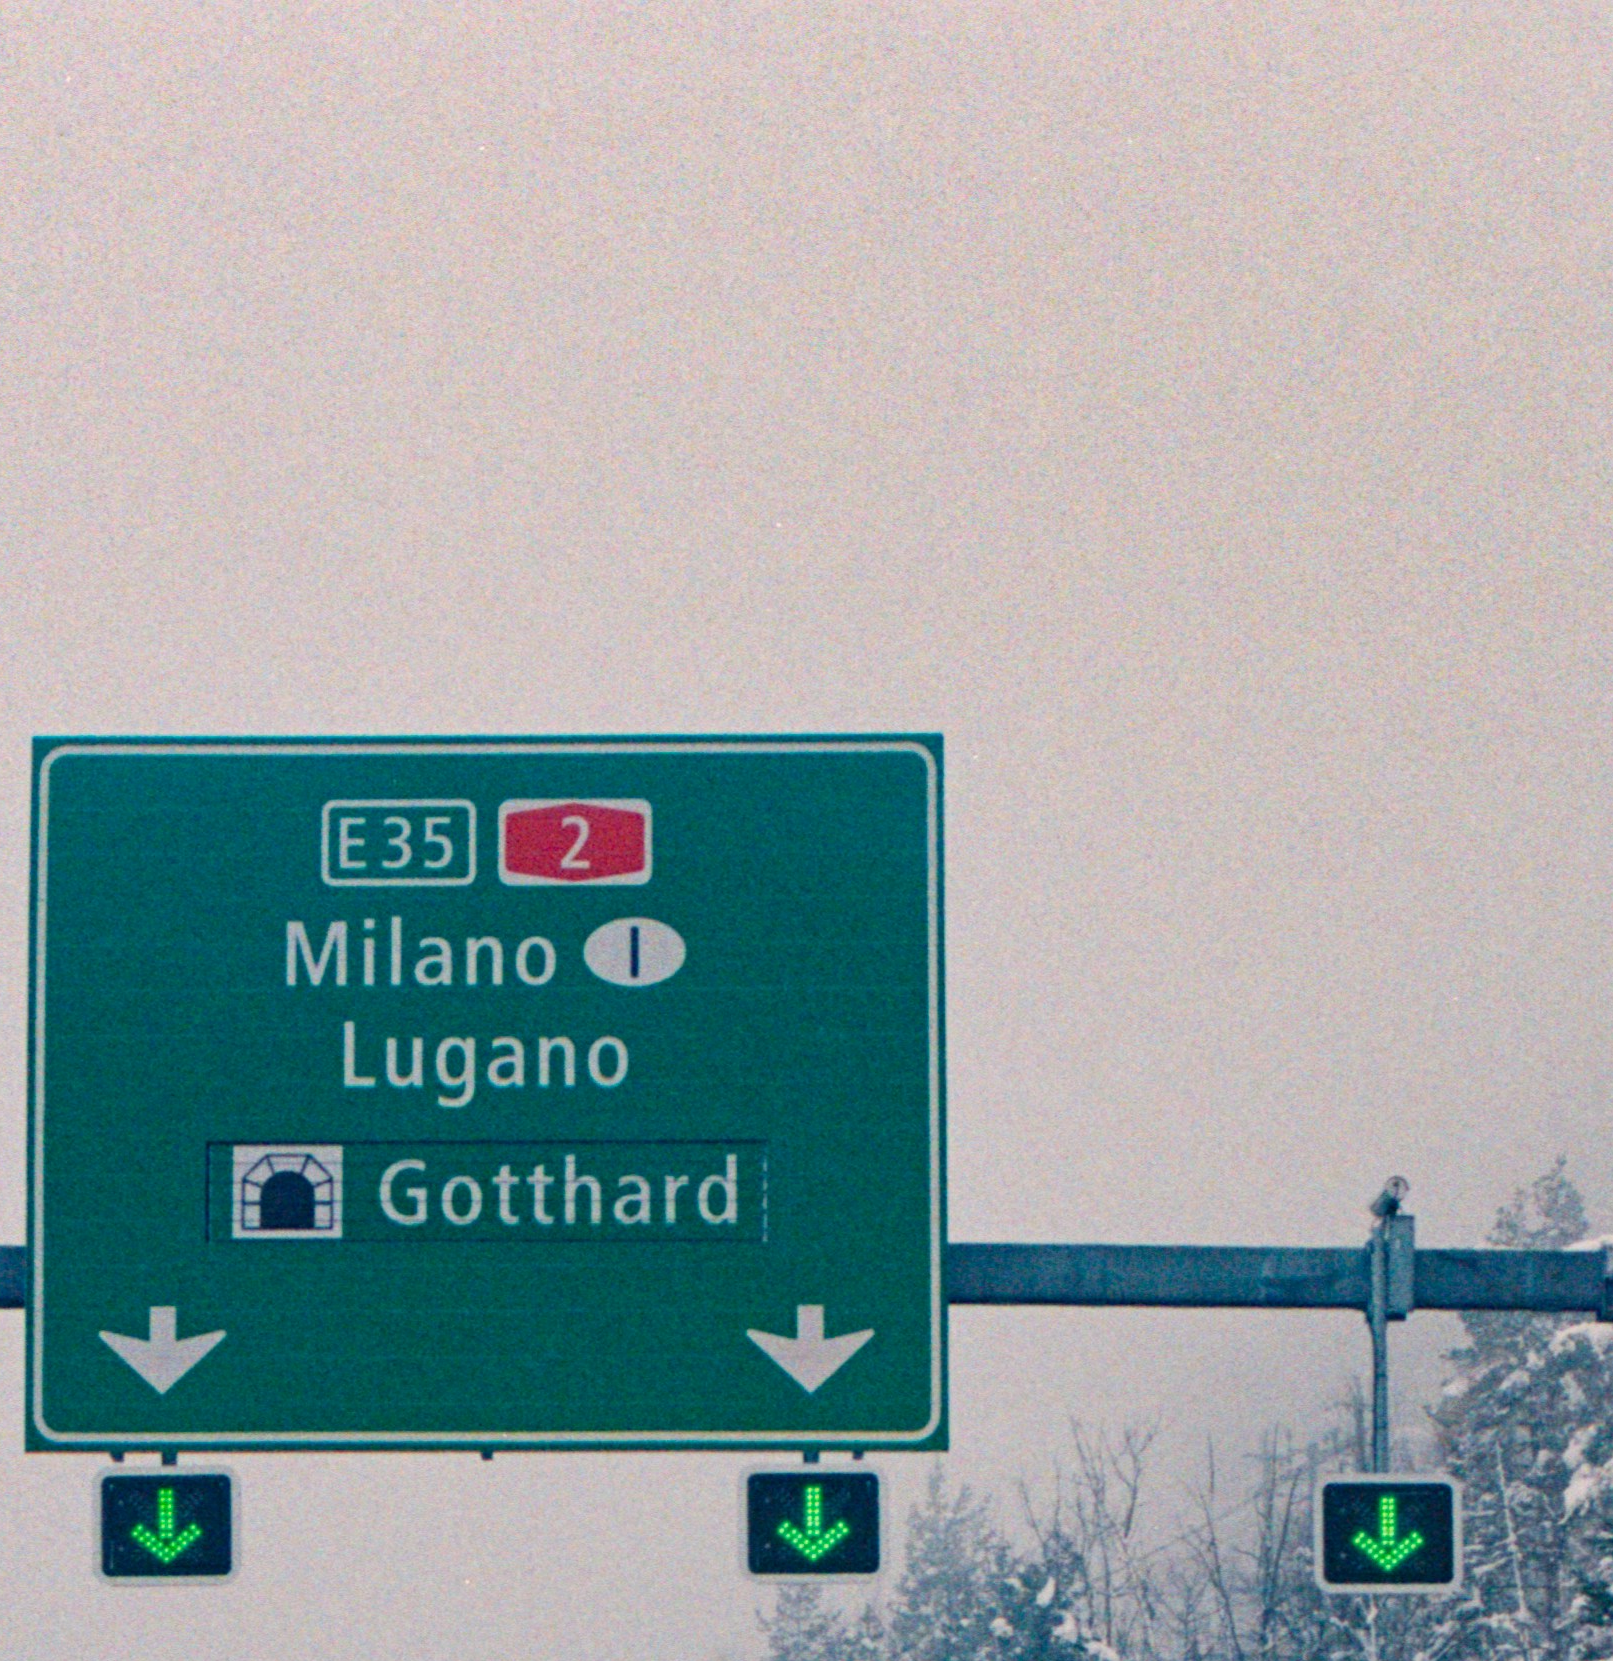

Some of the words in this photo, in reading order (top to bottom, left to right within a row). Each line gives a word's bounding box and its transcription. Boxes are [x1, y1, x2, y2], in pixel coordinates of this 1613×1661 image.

[339, 816, 454, 868] E35
[560, 815, 590, 869] 2
[285, 916, 556, 986] Milano
[630, 925, 640, 979] I
[343, 1020, 629, 1108] Lugano
[379, 1154, 738, 1225] Gotthard
